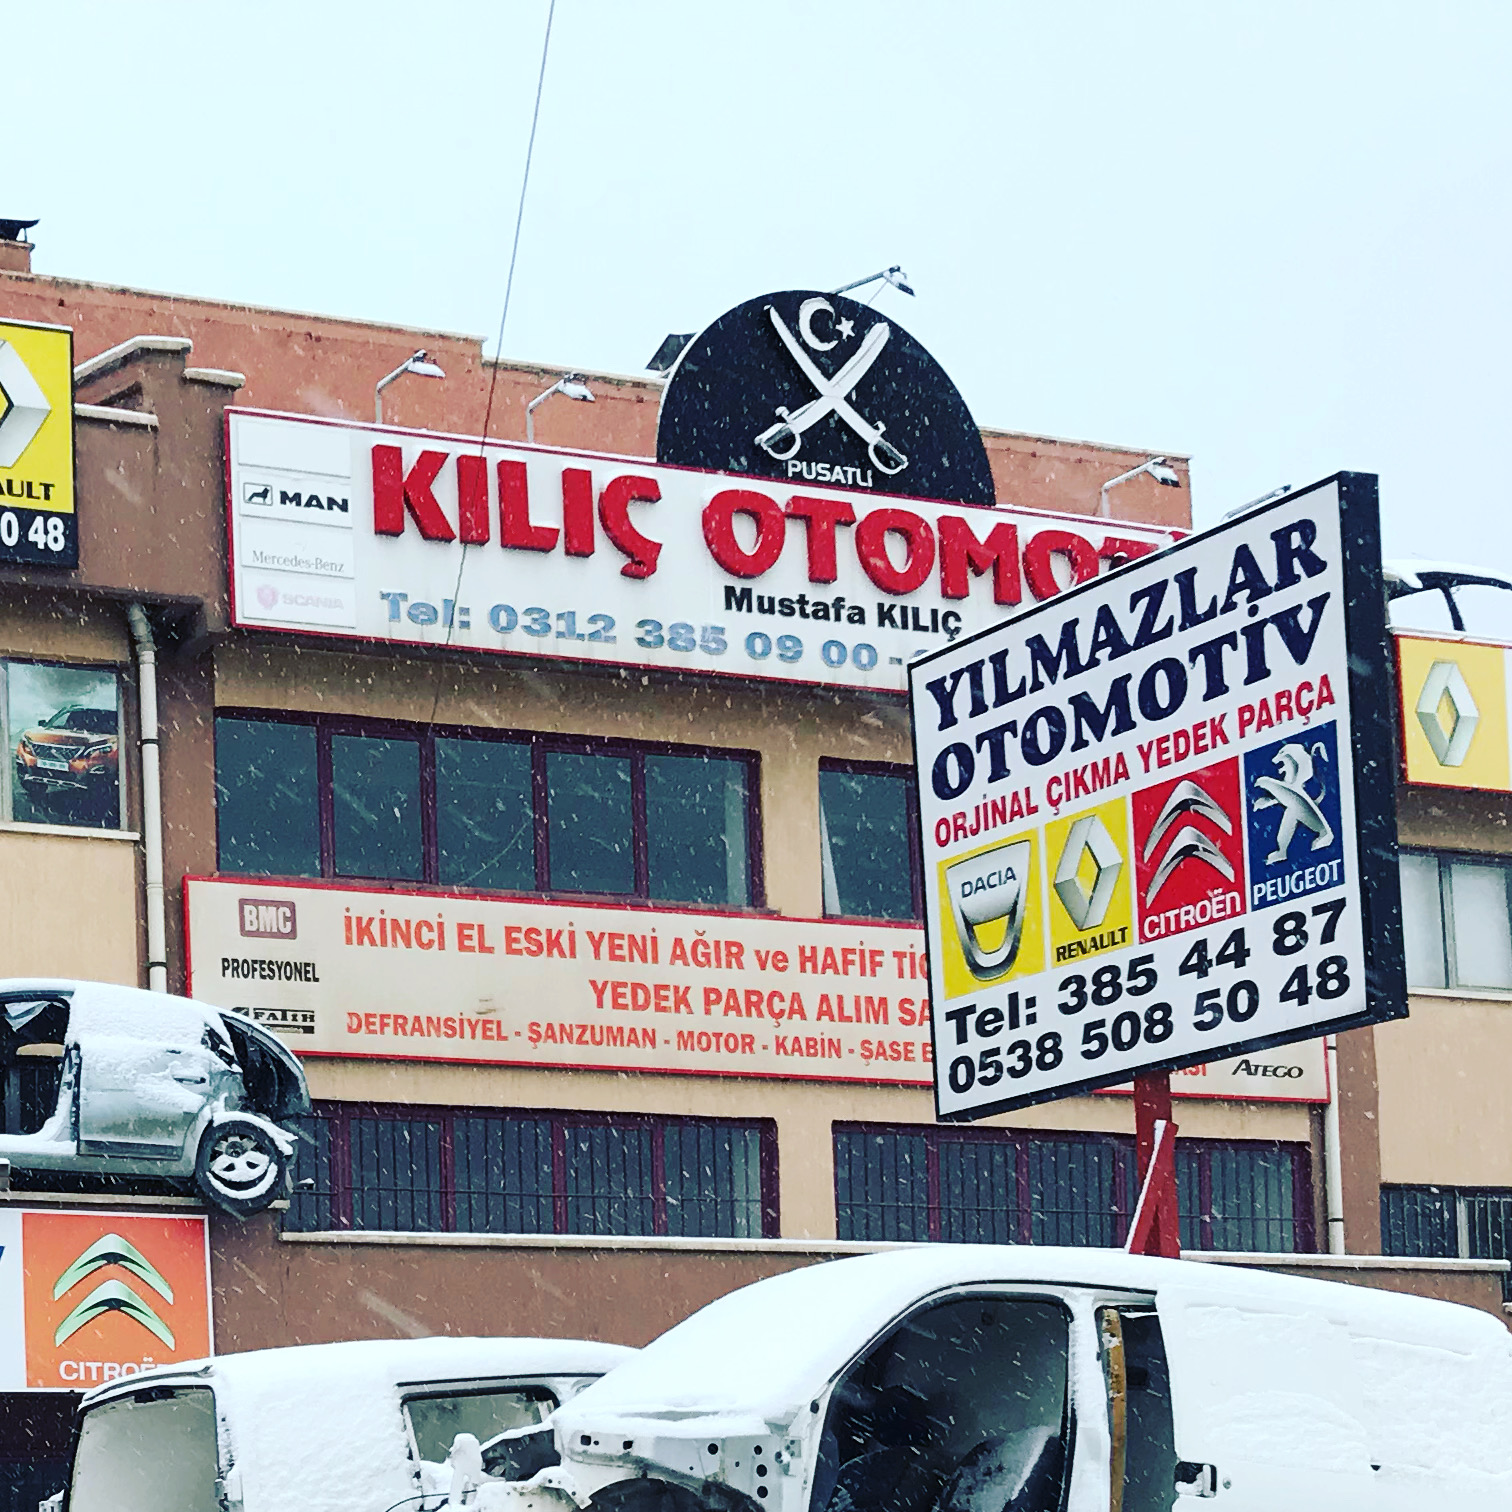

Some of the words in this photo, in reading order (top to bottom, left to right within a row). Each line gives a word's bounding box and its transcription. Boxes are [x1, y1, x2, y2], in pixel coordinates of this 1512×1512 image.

[788, 460, 873, 487] PUSATLI
[279, 490, 349, 513] MAN
[372, 444, 663, 579] KILIÇ
[28, 517, 65, 552] 48
[252, 549, 345, 573] Mercedes-Benz
[380, 591, 470, 630] Tel:
[488, 603, 618, 644] 0312
[635, 619, 728, 656] 385
[744, 631, 804, 663] 09
[821, 639, 879, 671] 00
[724, 586, 866, 625] Mustafa
[877, 602, 963, 642] KILIÇ
[925, 518, 1328, 732] YILMAZLAR
[932, 591, 1331, 801] OTOMOTİV
[934, 793, 1039, 848] ORJİNAL
[1045, 752, 1130, 820] ÇIKMA
[1136, 717, 1229, 774] YEDEK
[1238, 674, 1336, 740] PARÇA
[960, 866, 1017, 898] DACIA
[1253, 858, 1342, 905] PEUGEOT
[243, 904, 292, 934] BMC
[343, 907, 446, 951] İKİNCİ
[457, 922, 495, 954] EL
[504, 921, 577, 959] ESKİ
[585, 928, 659, 965] YENİ
[669, 929, 745, 971] AĞIR
[755, 949, 789, 973] ve
[799, 941, 885, 977] HAFİF
[1056, 926, 1129, 963] RENAULT
[221, 957, 320, 983] PROFESYONEL
[946, 991, 1039, 1046] Tel:
[1057, 954, 1158, 1016] 385
[1179, 927, 1251, 979] 44
[1273, 899, 1347, 958] 87
[588, 979, 694, 1015] YEDEK
[703, 987, 808, 1028] PARÇA
[817, 993, 890, 1026] ALIM
[898, 997, 931, 1027] SA
[948, 1031, 1063, 1094] 0538
[1081, 1001, 1174, 1061] 508
[1192, 979, 1259, 1032] 50
[1279, 954, 1351, 1008] 48
[347, 1011, 509, 1041] DEFRANSİYEL
[528, 1021, 657, 1050] ŞANZUMAN
[677, 1030, 755, 1055] MOTOR
[775, 1031, 842, 1059] KABİN
[1232, 1059, 1304, 1079] ATEGO
